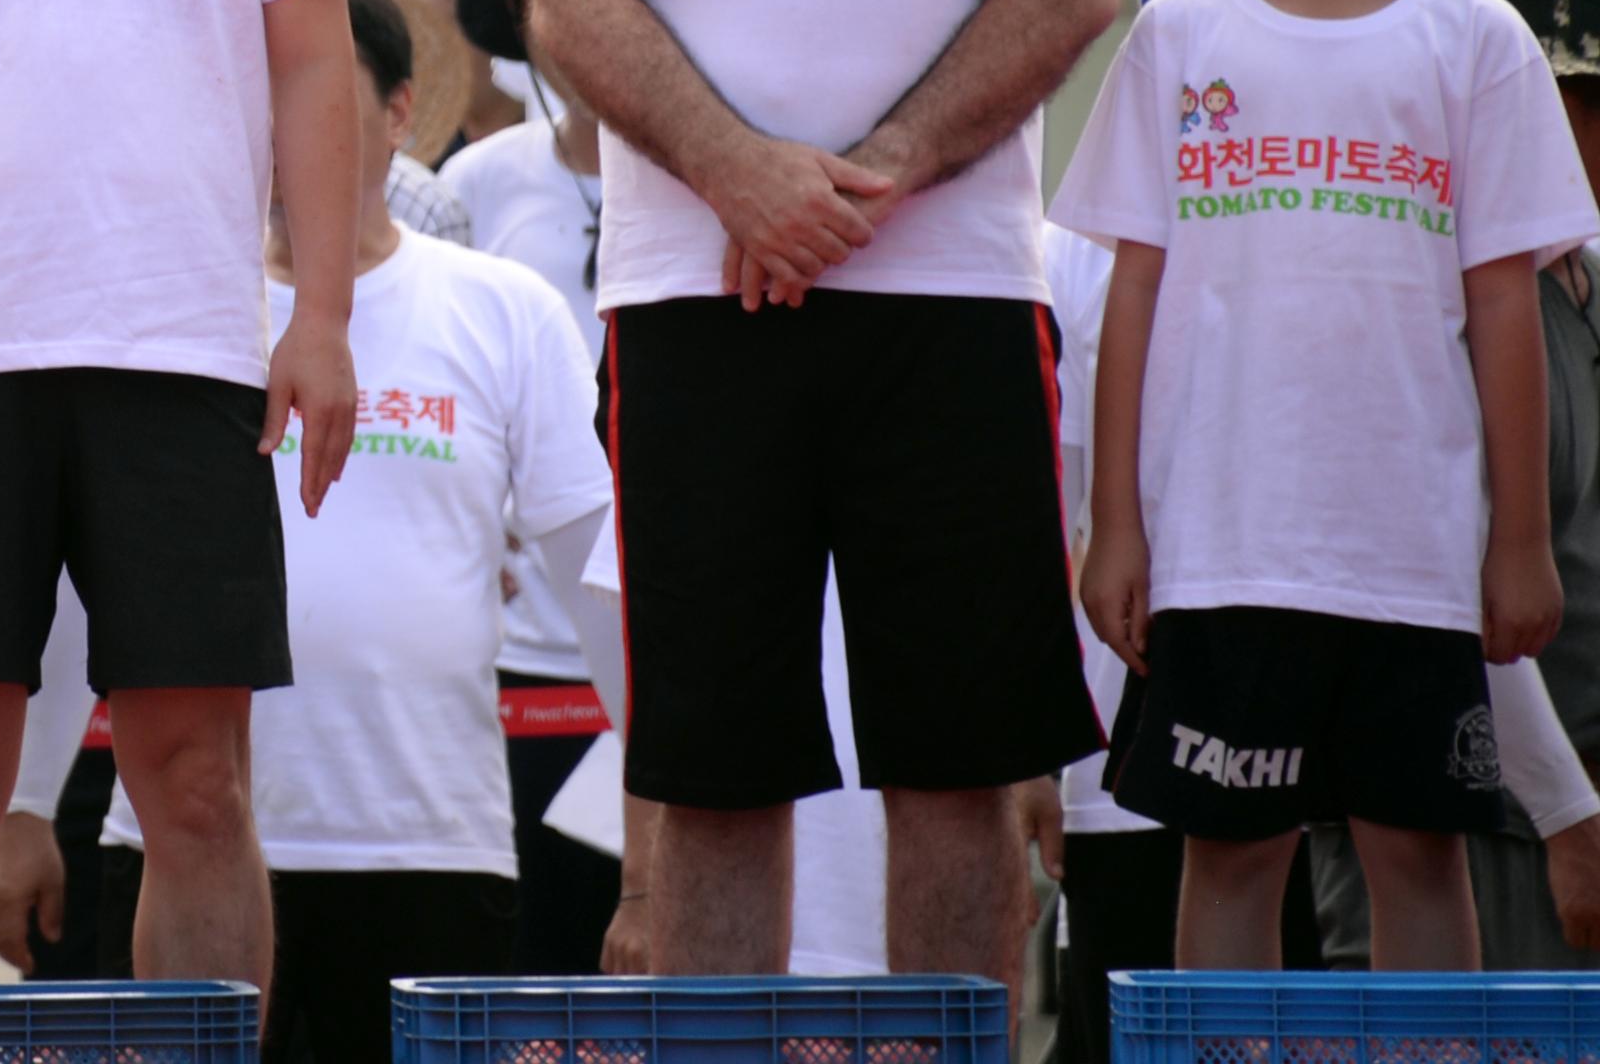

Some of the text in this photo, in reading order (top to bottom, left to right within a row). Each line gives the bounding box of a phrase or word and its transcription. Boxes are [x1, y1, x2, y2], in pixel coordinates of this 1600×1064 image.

[1177, 136, 1454, 207] 화천토마토축제
[1177, 186, 1303, 221] TOMATO
[1171, 723, 1304, 789] TAKHI
